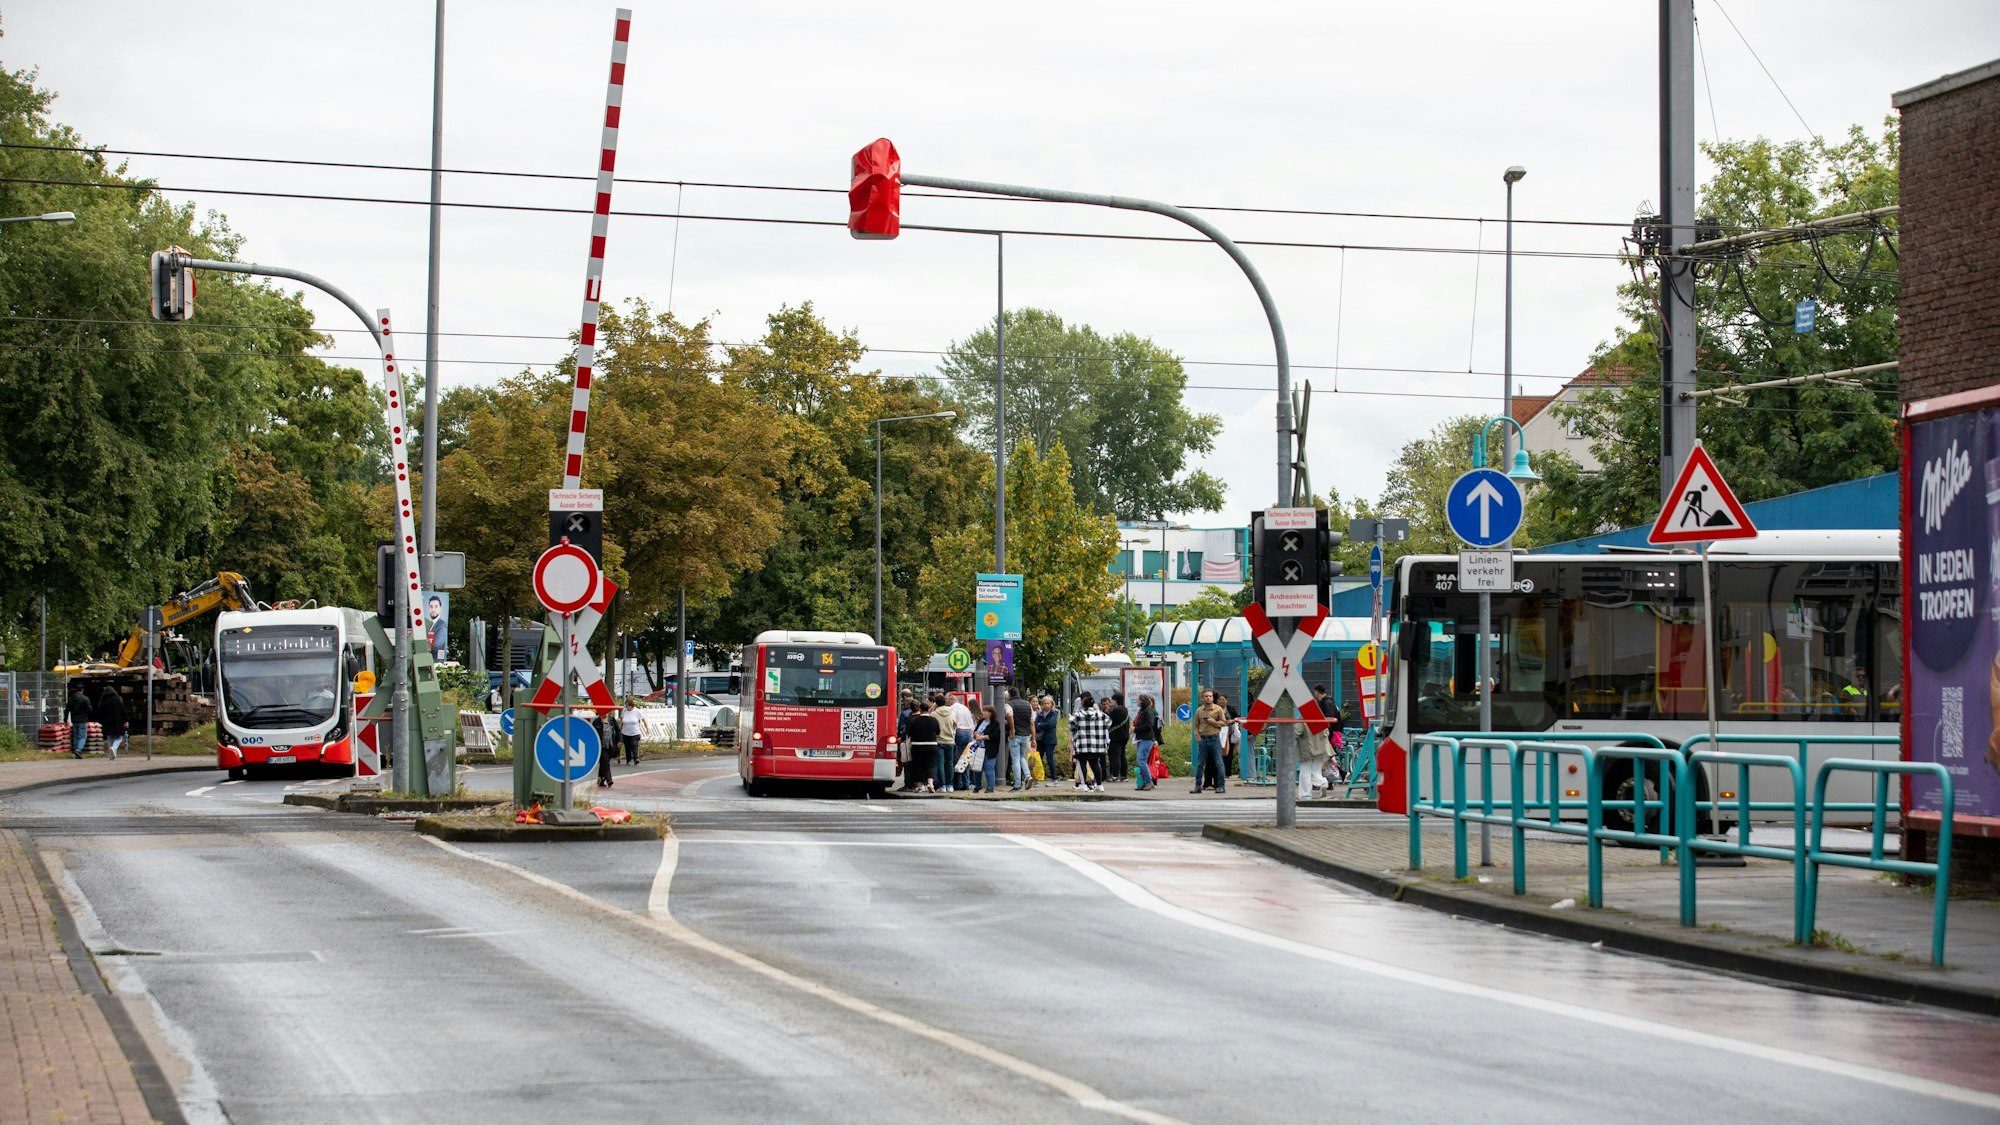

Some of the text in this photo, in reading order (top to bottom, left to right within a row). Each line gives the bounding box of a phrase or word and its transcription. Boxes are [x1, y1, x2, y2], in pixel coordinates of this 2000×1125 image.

[1919, 438, 1973, 536] Milka
[578, 492, 601, 501] Sicherung
[1292, 511, 1314, 519] Sicherung
[1469, 556, 1503, 564] Linien-
[1919, 554, 1932, 584] IN
[1933, 548, 1975, 583] JEDEM
[1466, 567, 1505, 575] verkehr
[1435, 582, 1453, 590] 407
[1477, 578, 1495, 586] frei
[1920, 588, 1975, 621] TROPFEN
[821, 652, 833, 664] 154
[953, 654, 964, 666] H
